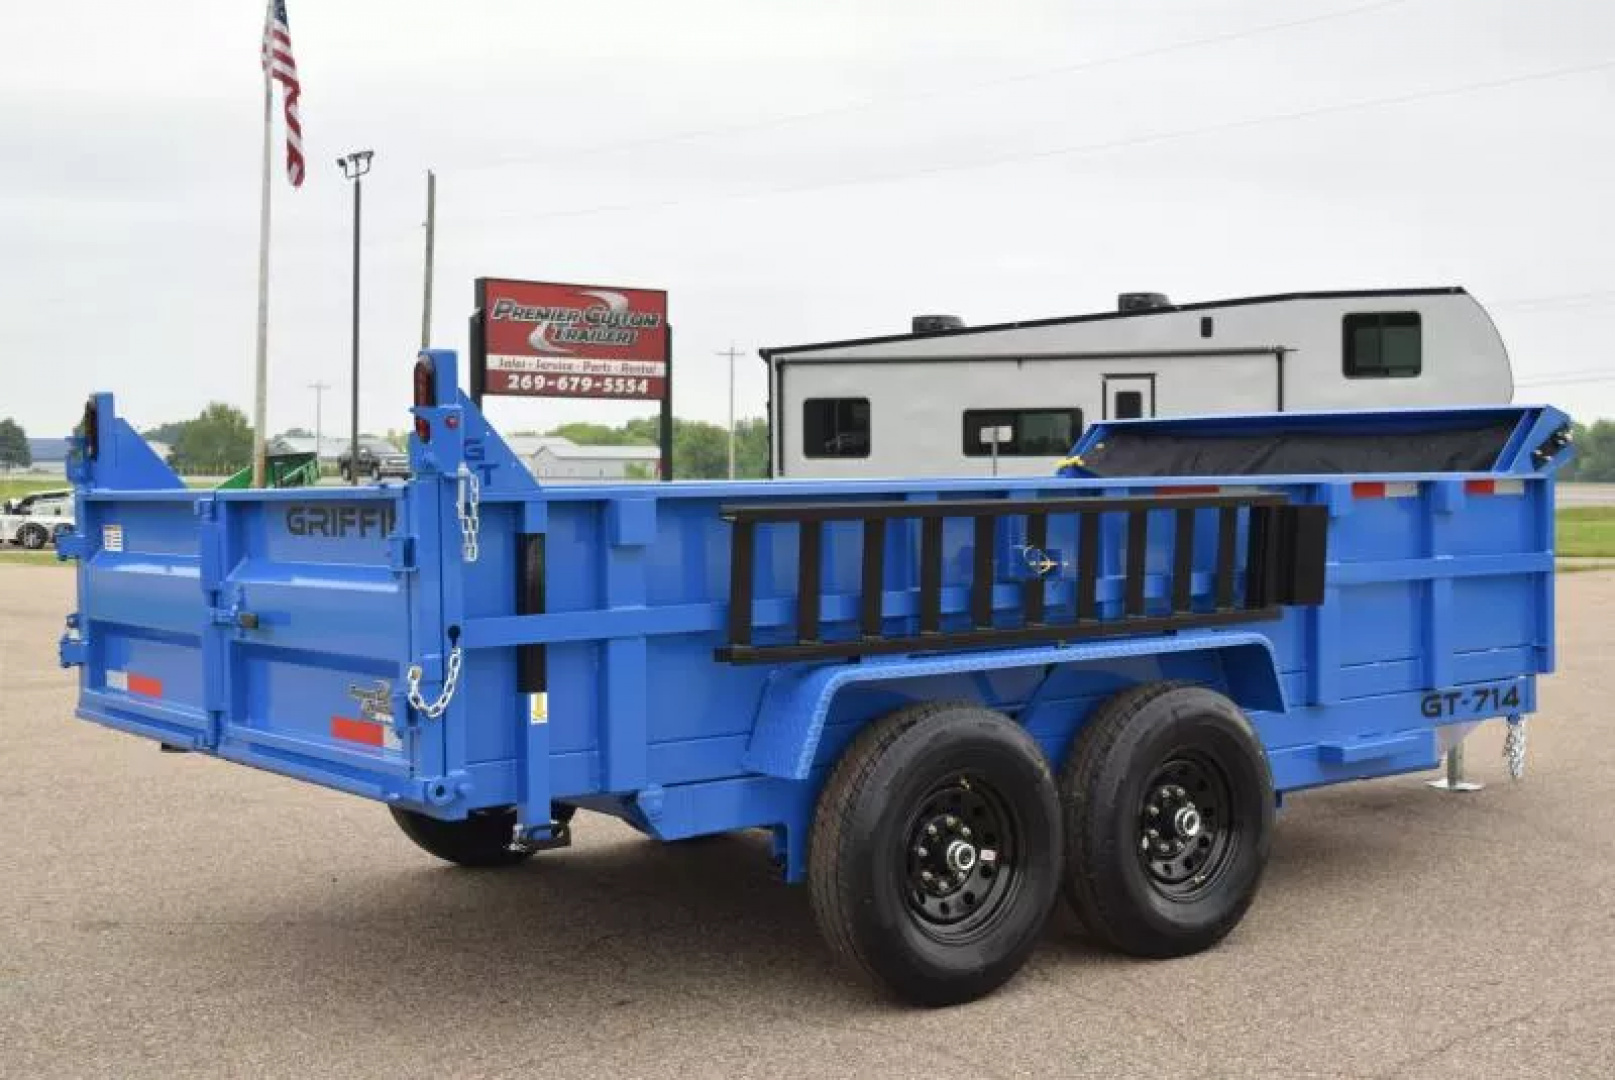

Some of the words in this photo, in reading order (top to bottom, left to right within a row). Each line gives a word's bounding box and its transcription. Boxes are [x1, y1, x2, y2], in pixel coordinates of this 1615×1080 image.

[583, 360, 611, 373] Parts
[508, 374, 649, 394] 269-679-5554
[1421, 685, 1519, 718] GT-714
